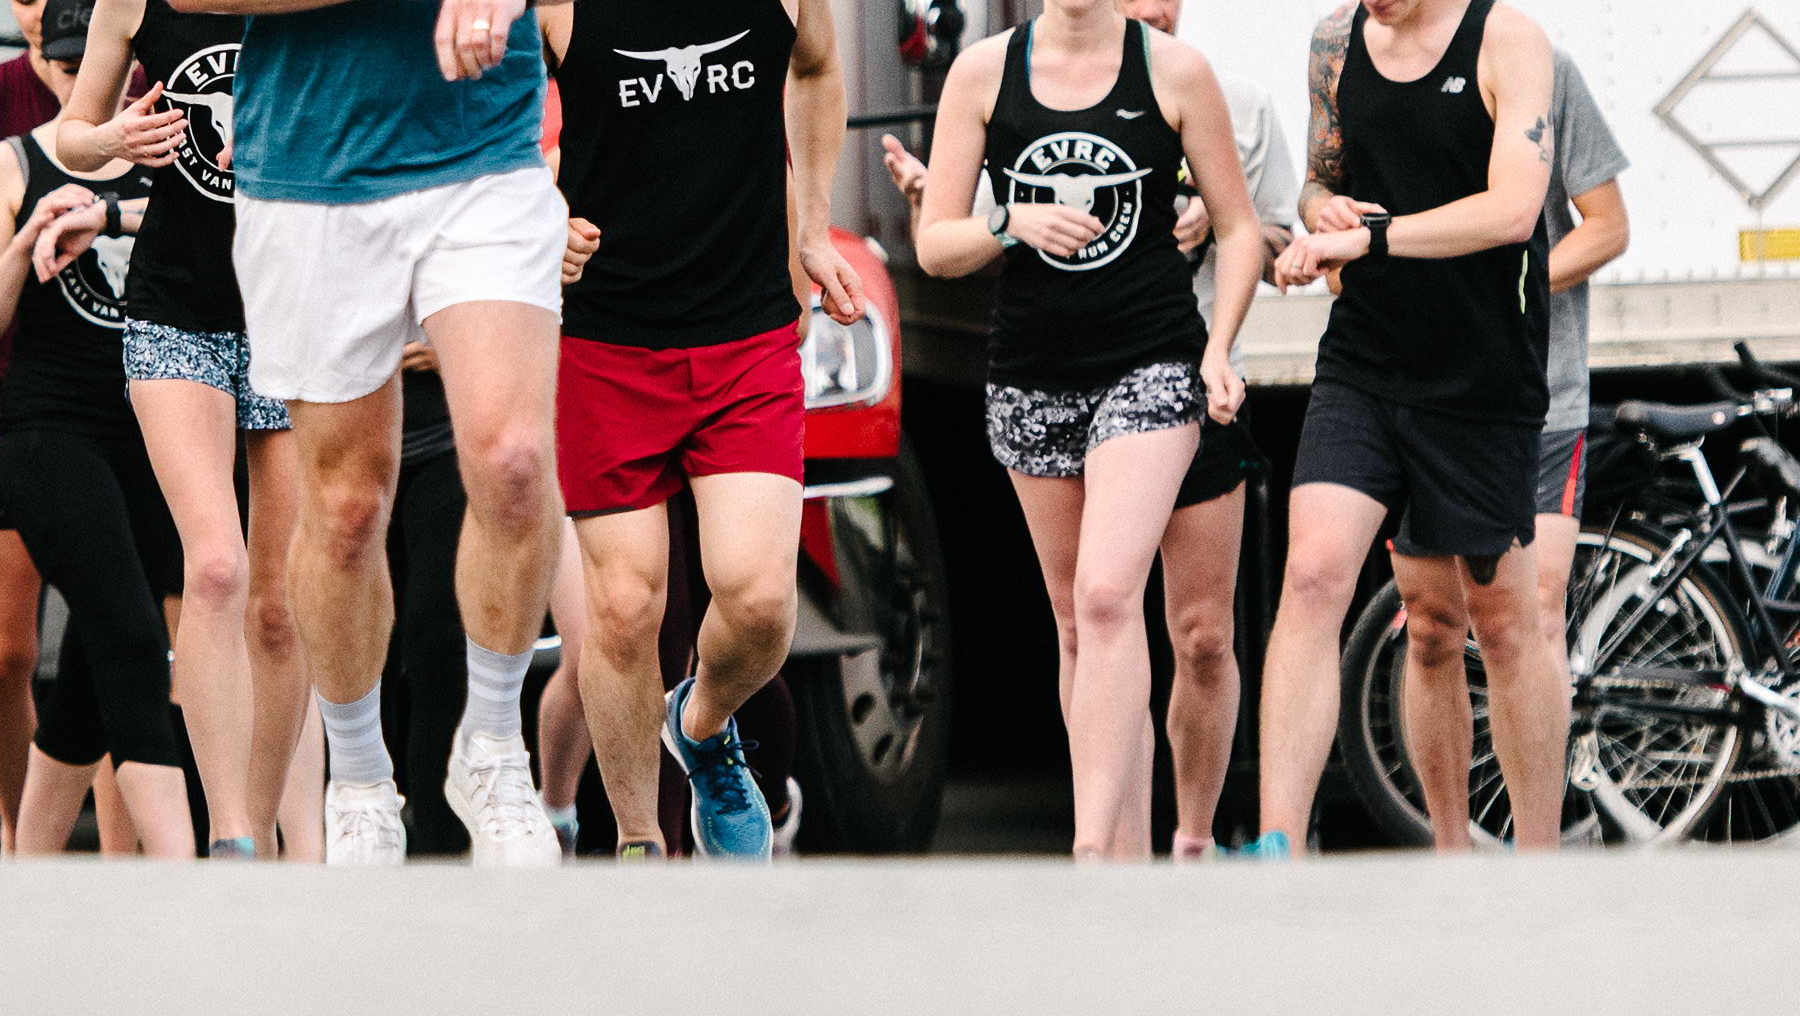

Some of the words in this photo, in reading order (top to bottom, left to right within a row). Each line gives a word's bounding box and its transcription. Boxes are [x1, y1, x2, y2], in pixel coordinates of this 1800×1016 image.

[185, 51, 240, 87] EV
[1030, 139, 1117, 172] EVRC
[201, 168, 232, 190] VAN
[1077, 240, 1109, 260] RUN
[1108, 201, 1133, 243] CREW
[92, 300, 120, 319] VAN
